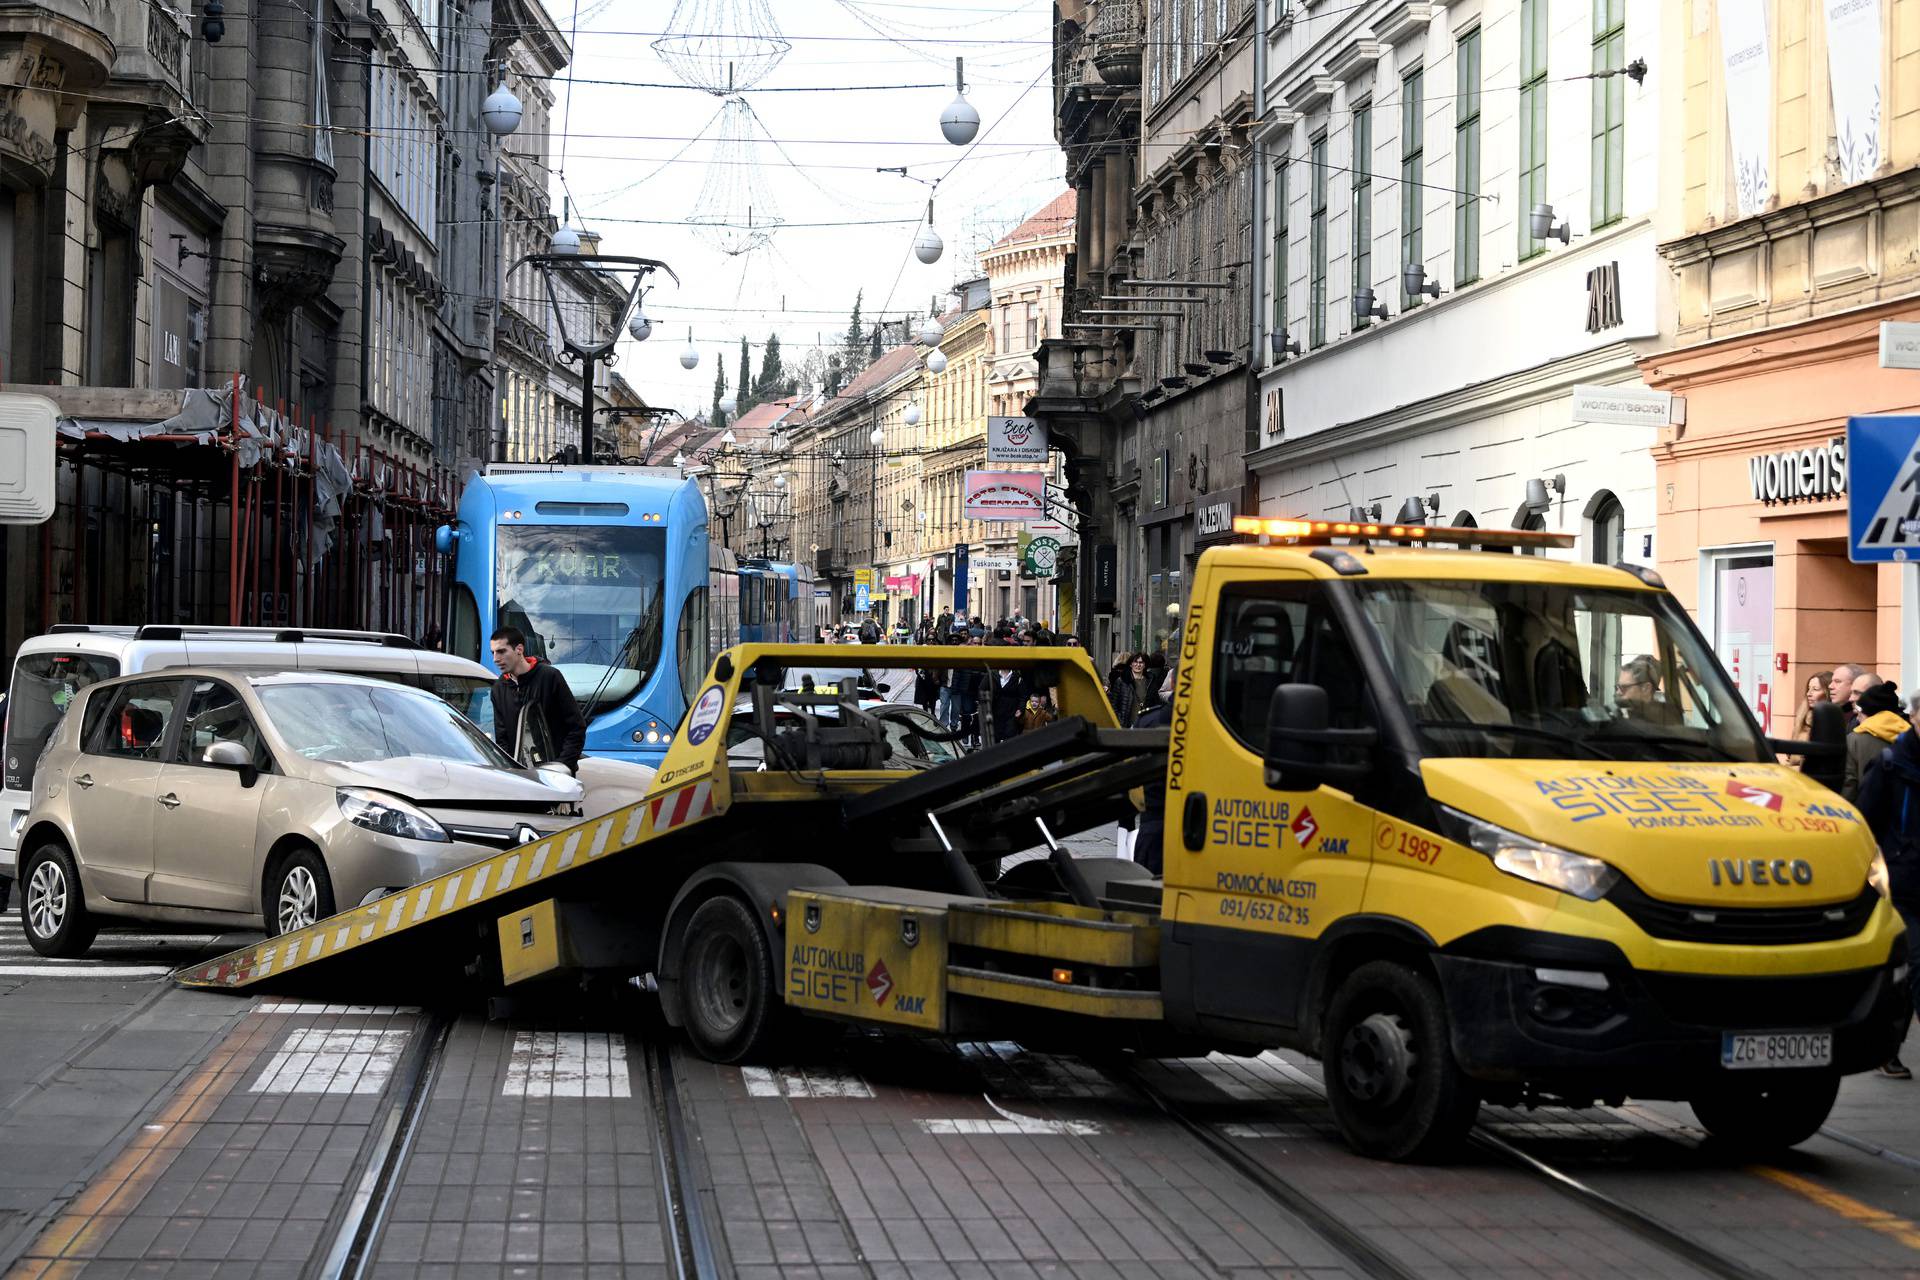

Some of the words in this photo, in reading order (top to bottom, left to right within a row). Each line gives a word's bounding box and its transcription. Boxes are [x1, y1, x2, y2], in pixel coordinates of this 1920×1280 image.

[1001, 485, 1043, 507] STUDIO
[538, 553, 620, 579] KVAR
[972, 559, 1002, 568] Tuškanac
[1184, 604, 1203, 660] CESTI
[1178, 665, 1194, 698] NA
[1533, 775, 1709, 797] AUTOKLUB
[1213, 798, 1290, 822] AUTOKLUB
[1551, 790, 1729, 823] SIGET
[1212, 819, 1289, 849] SIGET
[1318, 837, 1350, 855] HAK
[1697, 815, 1721, 828] NA
[1724, 814, 1764, 829] CESTI
[1794, 816, 1842, 835] 1987
[1397, 831, 1443, 866] 1987
[1216, 871, 1264, 895] POMOĆ
[1266, 876, 1285, 896] NA
[1286, 879, 1317, 900] CESTI
[1707, 857, 1814, 886] IVECO
[1219, 898, 1274, 921] 091/652
[1278, 903, 1292, 924] 62
[1295, 906, 1310, 926] 35
[791, 943, 865, 974] AUTOKLUB
[790, 967, 865, 1005] SIGET
[894, 992, 926, 1015] HAK
[1735, 1036, 1756, 1061] ZG
